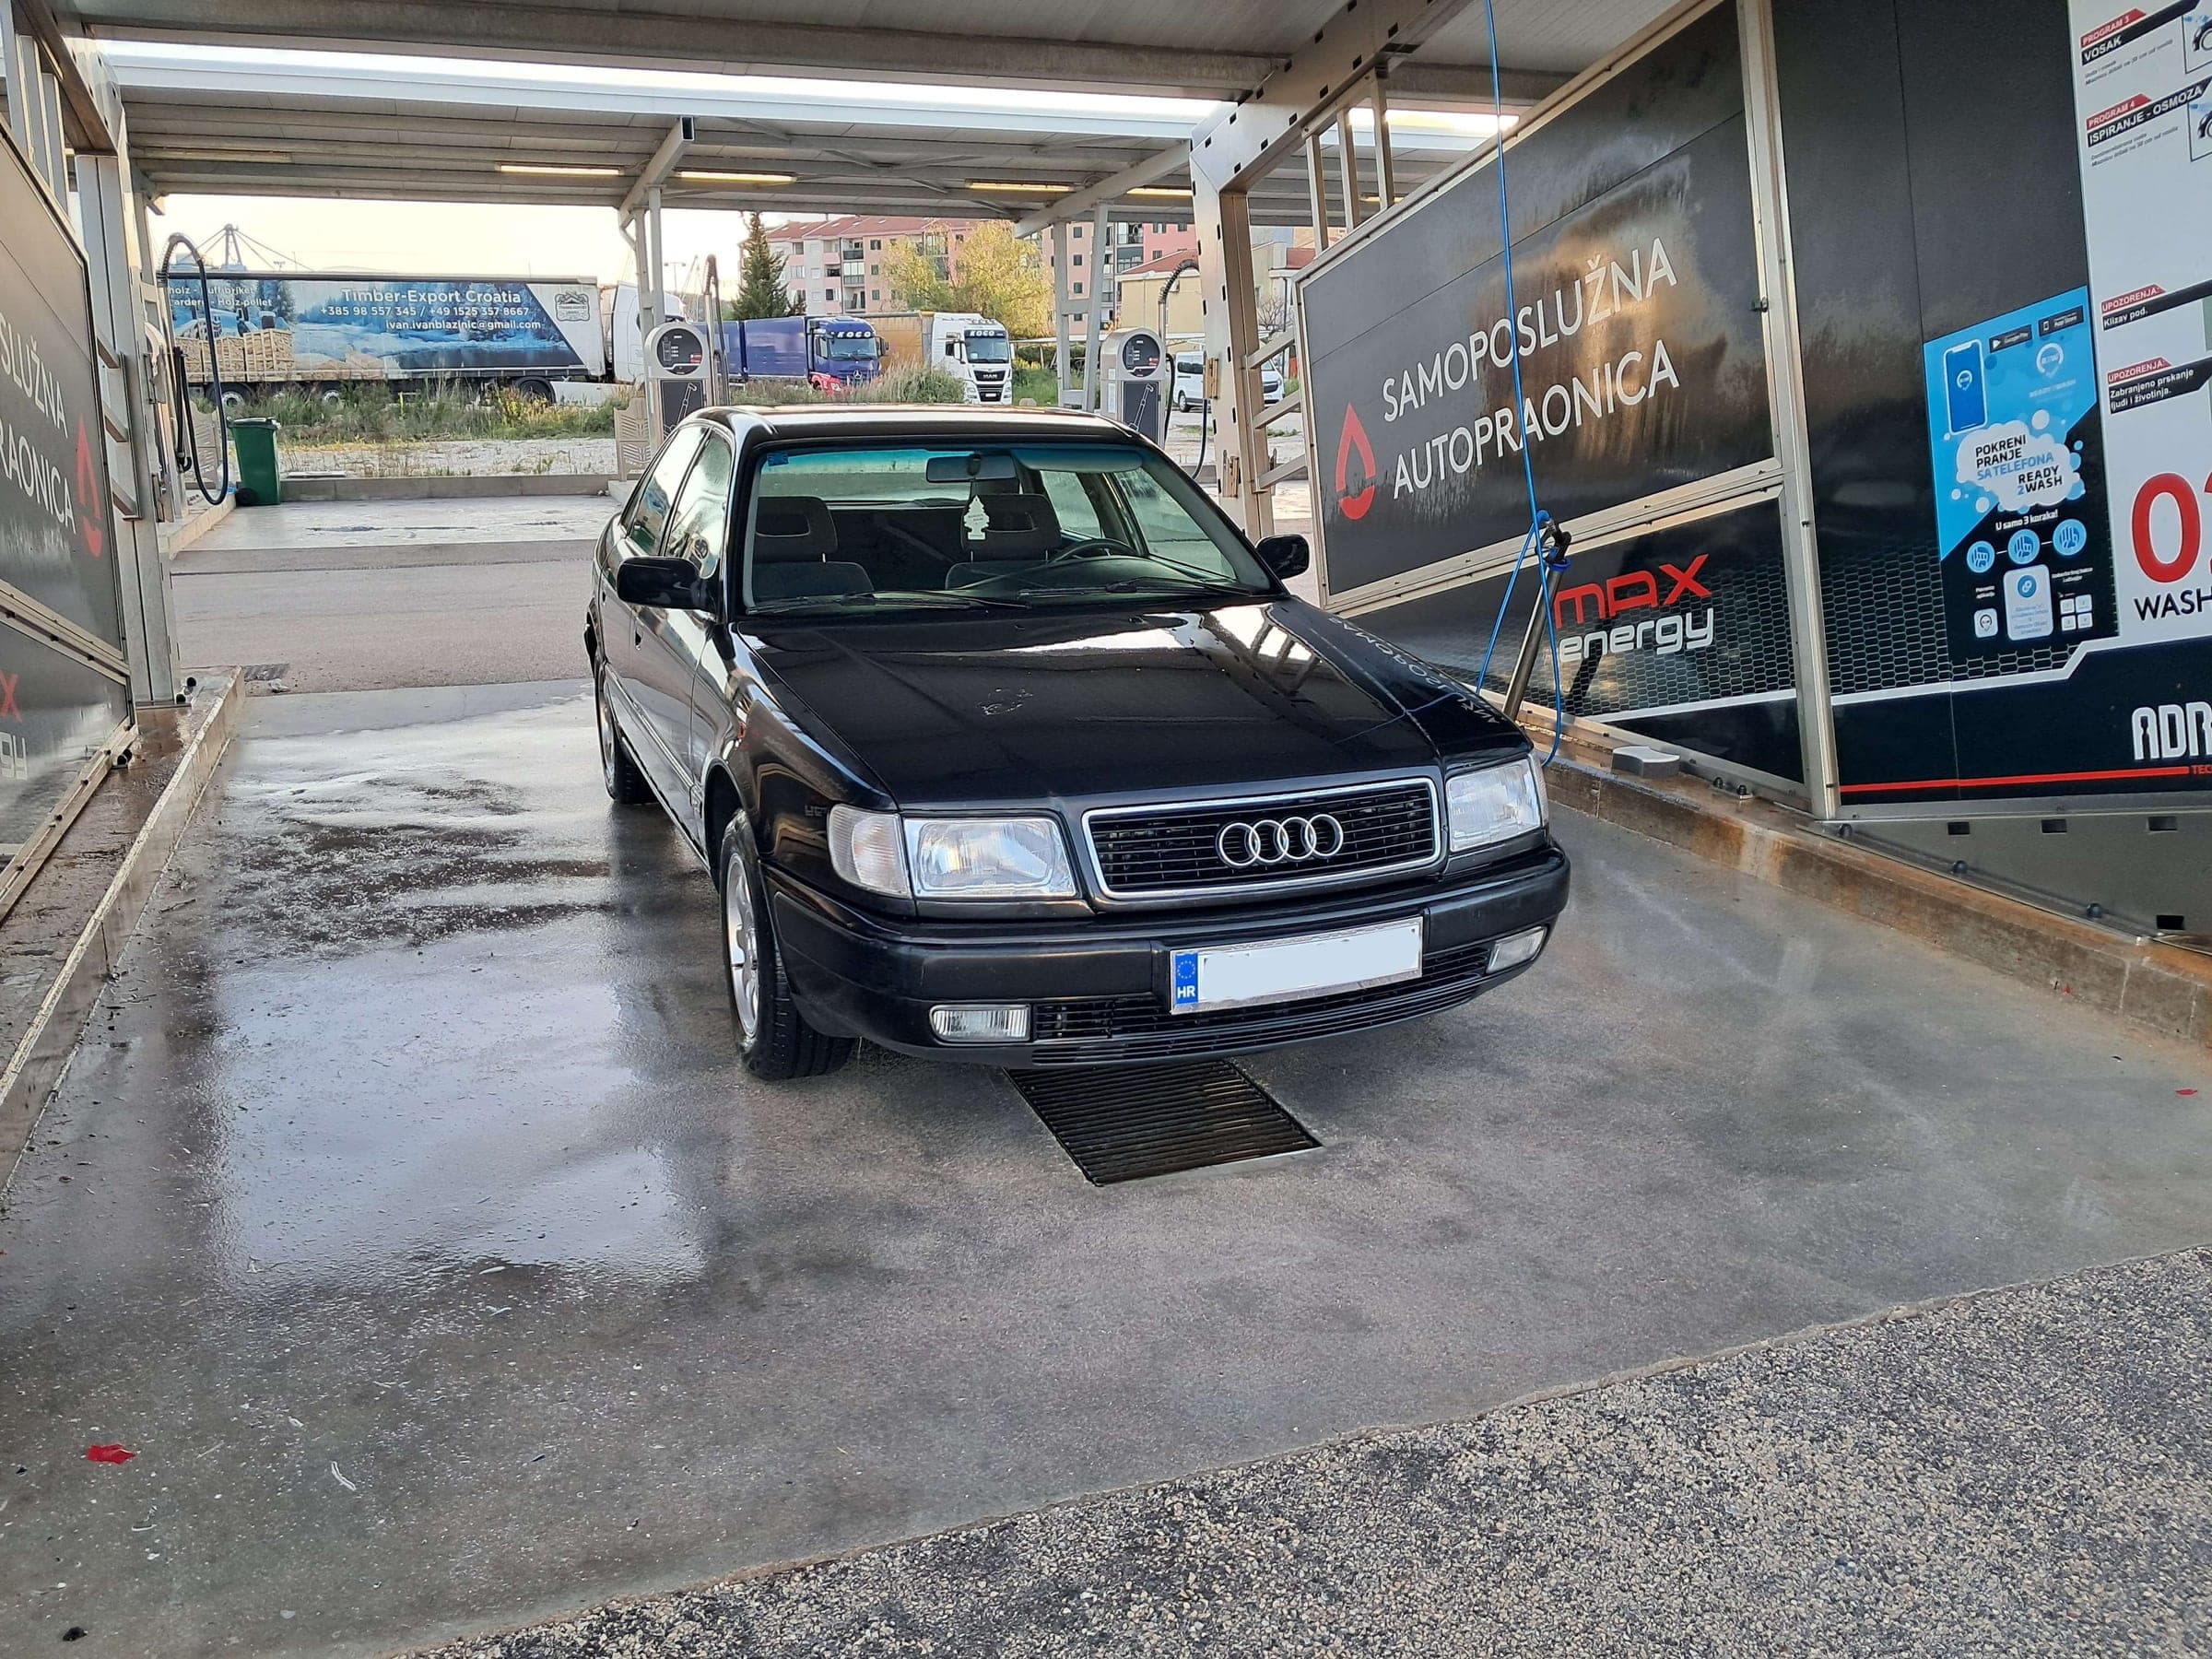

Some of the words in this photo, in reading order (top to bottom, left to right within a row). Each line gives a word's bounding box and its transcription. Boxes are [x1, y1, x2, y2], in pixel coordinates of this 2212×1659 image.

[2082, 18, 2124, 46] PROGRAM
[2083, 35, 2122, 62] VOSAK
[2088, 103, 2129, 128] PROGRAM
[2089, 112, 2145, 145] ISPIRANJE
[2153, 86, 2204, 115] OSMOZA
[341, 288, 461, 305] Timber-Export
[465, 289, 522, 303] Croatia
[2101, 287, 2160, 312] UPOZORENJA:
[320, 306, 349, 316] +385
[353, 307, 368, 316] 98
[371, 307, 391, 316] 557
[395, 307, 417, 316] 345
[429, 307, 450, 316] +49
[453, 307, 477, 316] 1525
[481, 307, 499, 316] 357
[503, 307, 529, 316] 8667
[2103, 312, 2128, 328] Klizav
[2130, 307, 2148, 320] pod.
[1382, 237, 1677, 423] SAMOPOSLUŽNA
[2108, 359, 2167, 382] UPOZORENJA:
[2110, 379, 2157, 399] Zabranjeno
[2157, 369, 2194, 388] prskanje
[1393, 339, 1681, 500] AUTOPRAONICA
[1975, 433, 2027, 458] POKRENI
[1976, 447, 2023, 469] PRANJE
[1977, 468, 1993, 480] SA
[1994, 452, 2054, 477] TELEFONA
[2018, 465, 2060, 485] READY
[1994, 521, 2003, 531] U
[2023, 514, 2030, 525] 3
[1559, 606, 1714, 663] energy
[1177, 985, 1195, 999] HR
